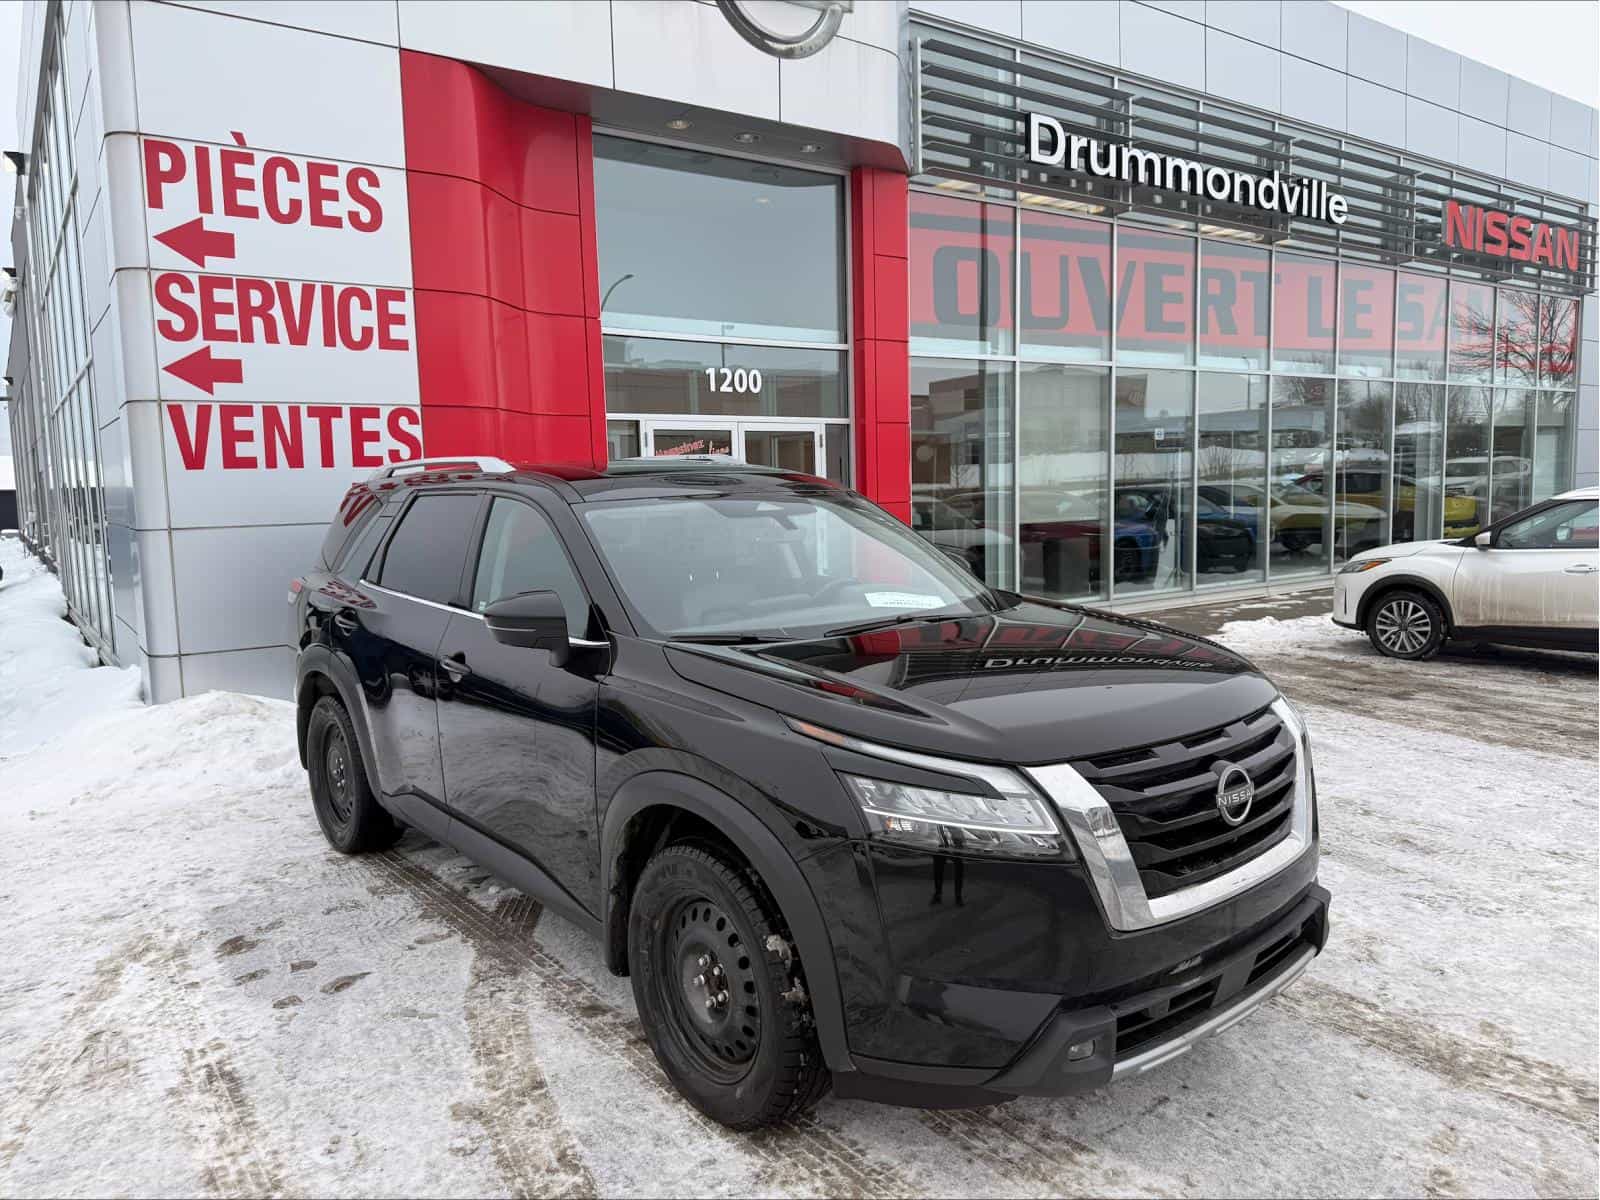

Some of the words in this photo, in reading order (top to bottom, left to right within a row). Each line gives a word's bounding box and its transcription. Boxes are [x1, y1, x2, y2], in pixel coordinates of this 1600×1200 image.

[143, 131, 383, 233] PIÈCES
[1029, 112, 1348, 224] Drummondville
[1445, 199, 1579, 272] NISSAN
[154, 272, 409, 351] SERVICE
[933, 245, 1282, 337] OUVERT
[1307, 276, 1373, 339] LE
[705, 367, 762, 393] 1200
[167, 404, 422, 470] VENTES
